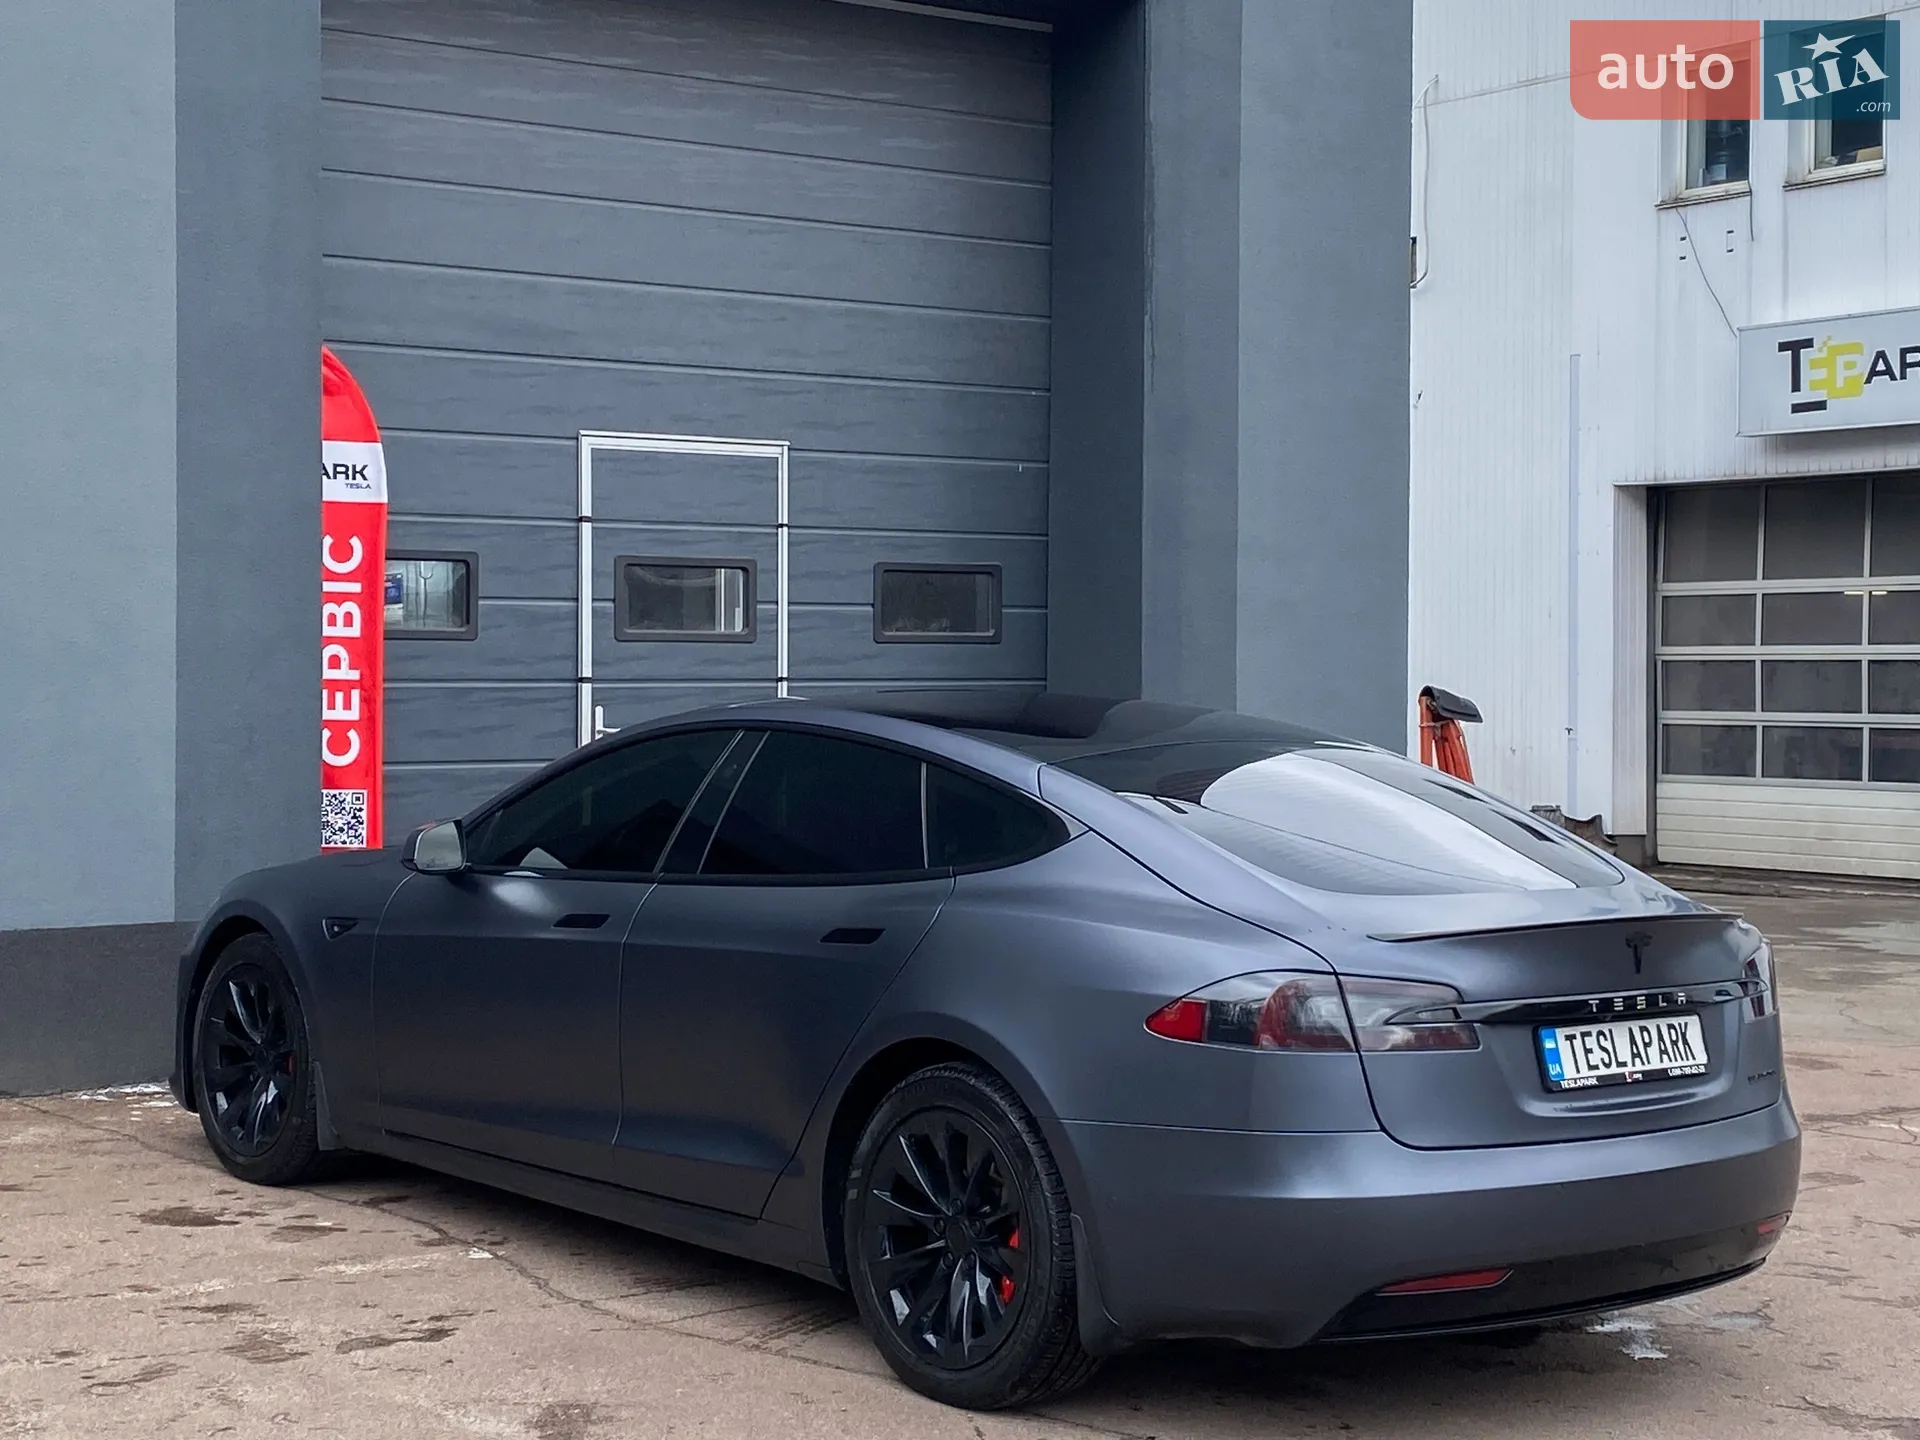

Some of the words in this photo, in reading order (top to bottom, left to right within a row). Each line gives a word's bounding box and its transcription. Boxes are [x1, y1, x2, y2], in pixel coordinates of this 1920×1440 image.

[344, 482, 372, 490] TESLA
[322, 534, 364, 767] СЕРВІС
[1588, 992, 1687, 1013] TESLA
[1564, 1022, 1696, 1075] TESLAPARK
[1548, 1063, 1562, 1076] UA
[1560, 1076, 1599, 1089] TESLAPARK
